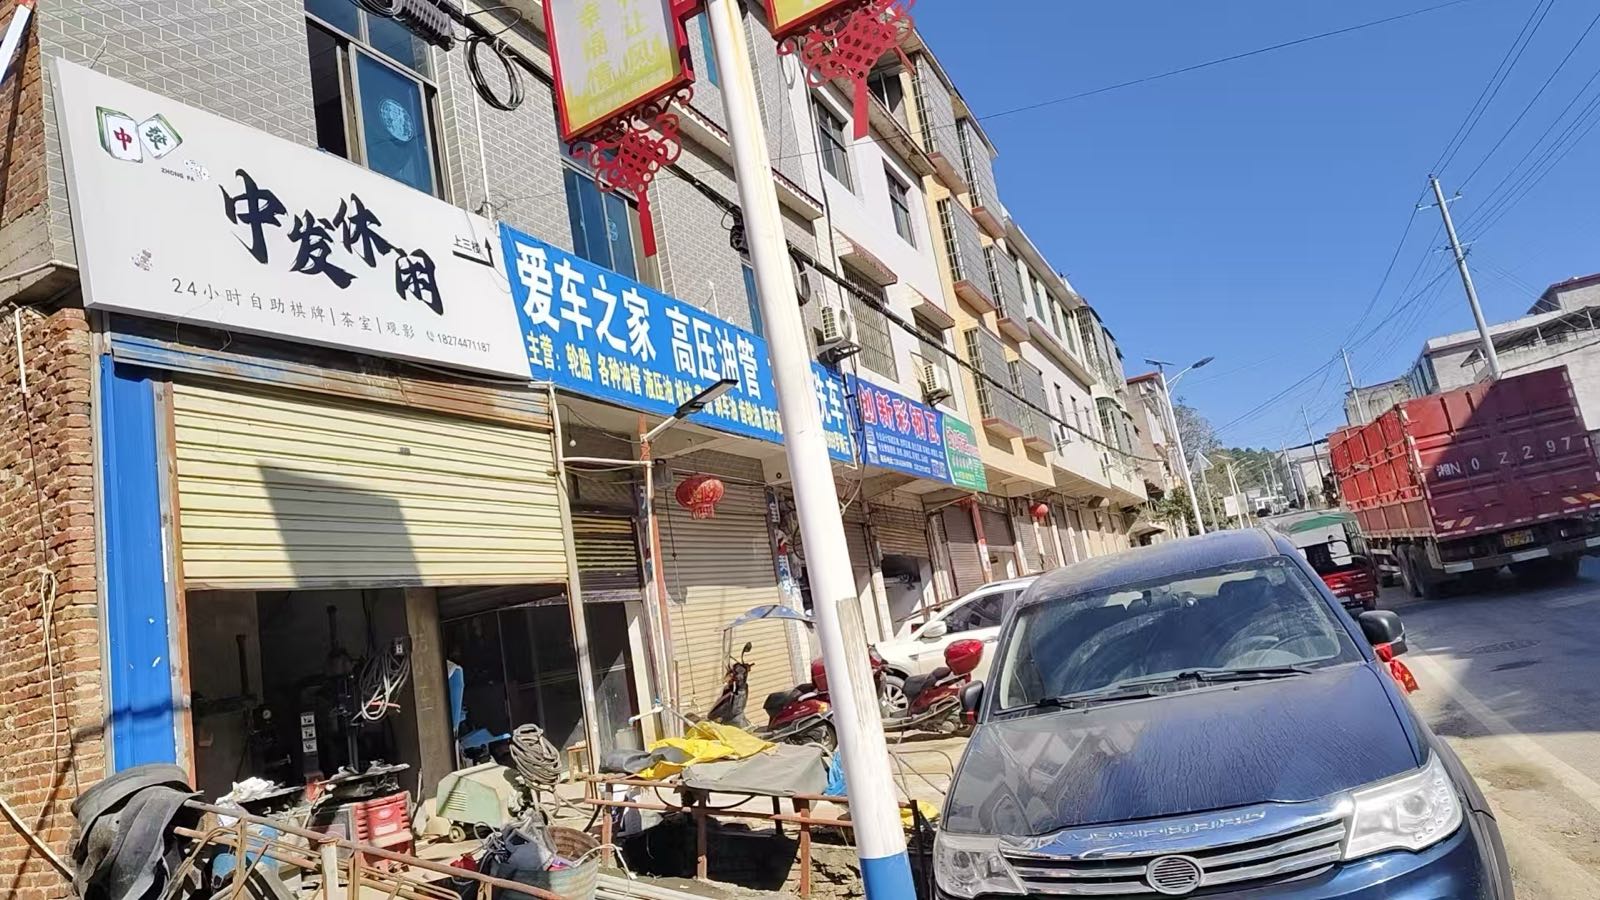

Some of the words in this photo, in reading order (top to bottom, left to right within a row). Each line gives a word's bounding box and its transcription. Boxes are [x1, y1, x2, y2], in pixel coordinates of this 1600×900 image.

[113, 126, 132, 151] 中
[160, 167, 184, 180] ZHONG
[218, 167, 444, 316] 中发休闲
[453, 234, 481, 254] 上三楼
[514, 240, 657, 363] 爱车之家
[665, 305, 762, 400] 高压油管
[565, 341, 593, 382] 轮胎
[597, 351, 642, 397] 各种油管
